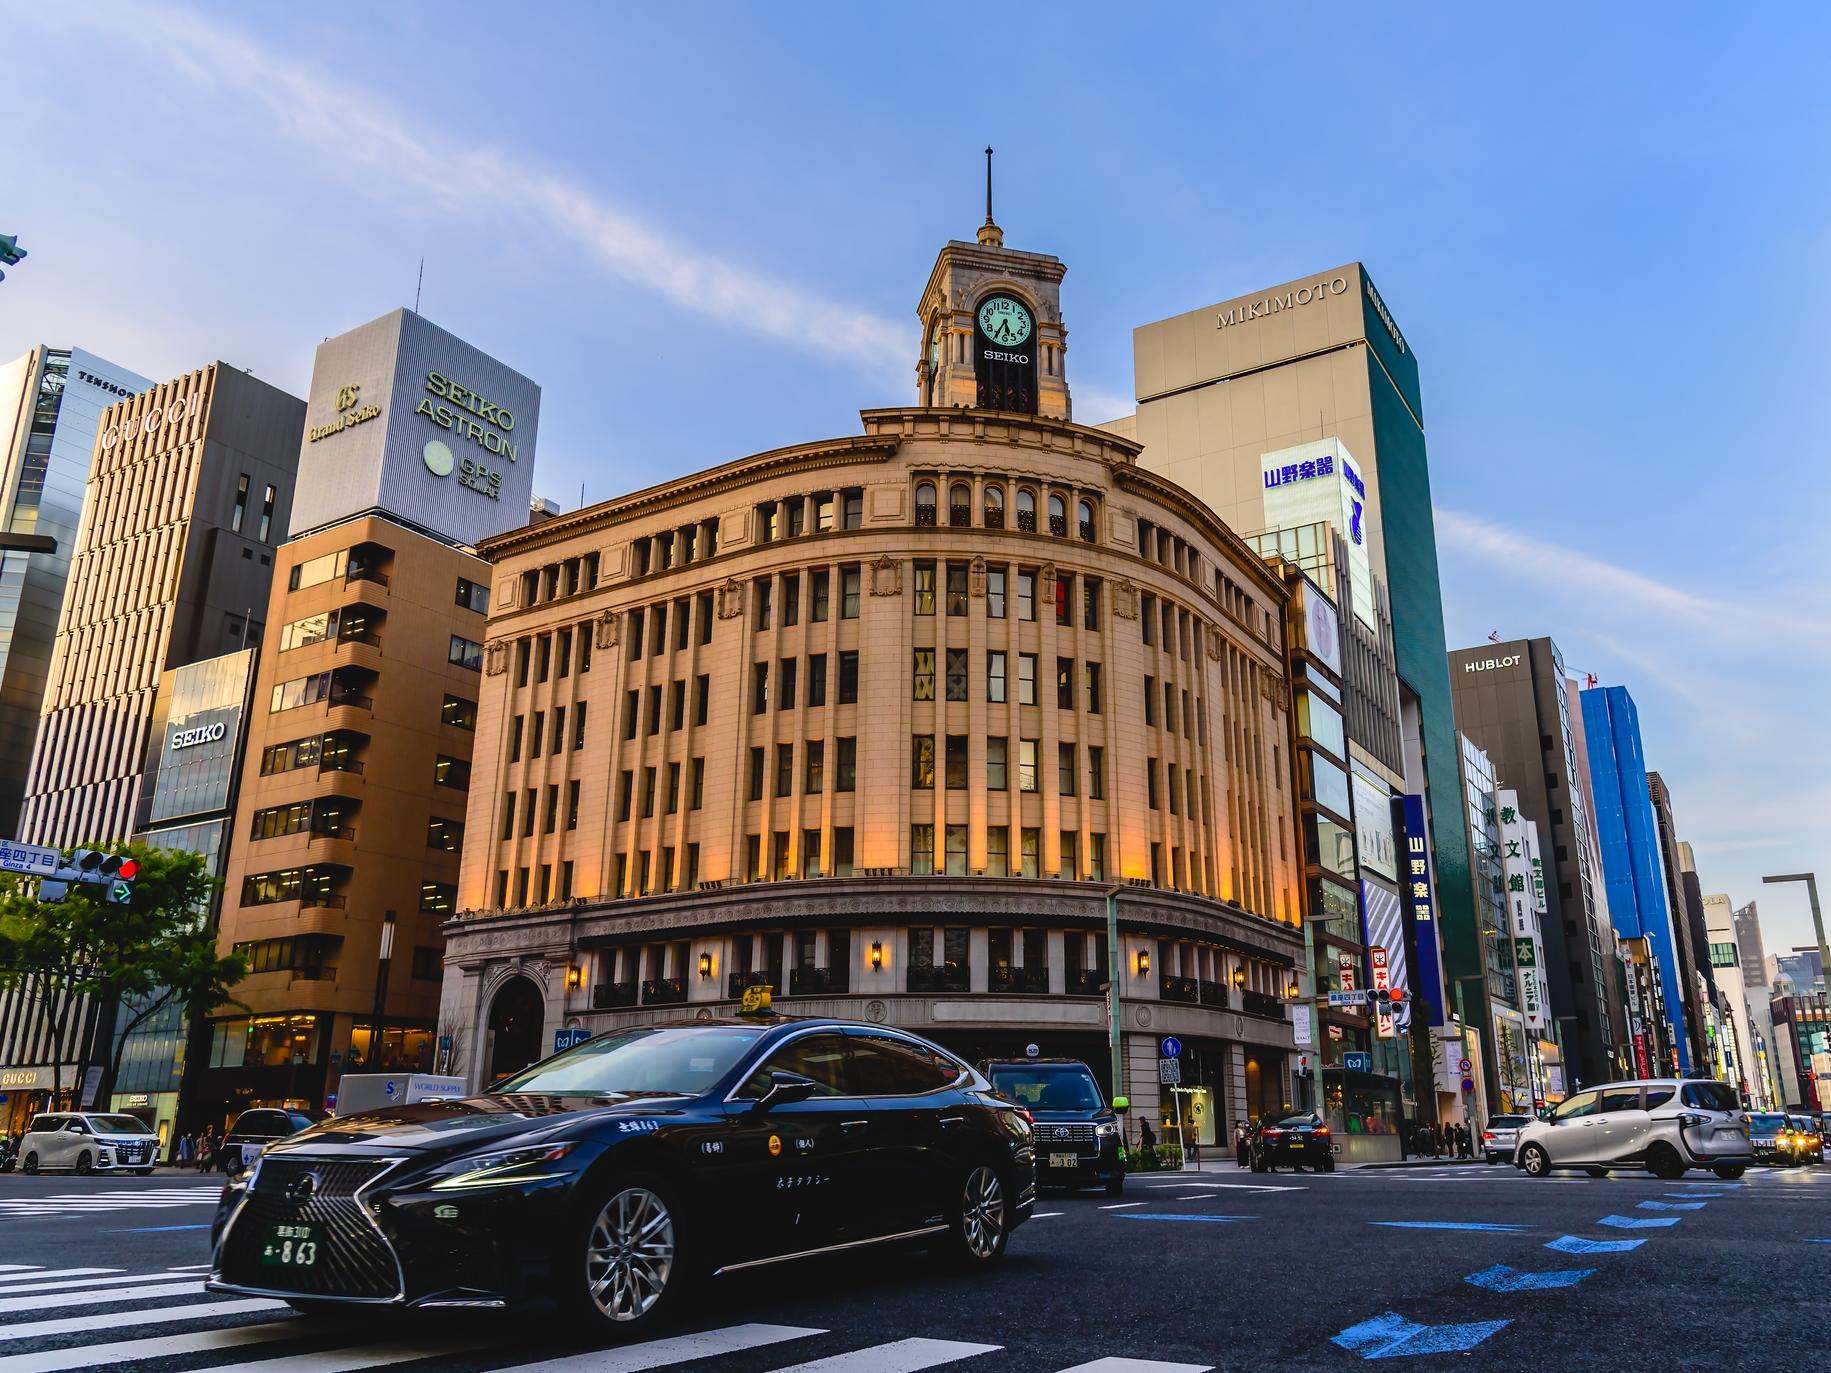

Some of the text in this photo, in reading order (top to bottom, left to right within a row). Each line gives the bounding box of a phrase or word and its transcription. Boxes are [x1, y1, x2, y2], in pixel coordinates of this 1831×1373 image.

[986, 307, 994, 315] 10
[993, 302, 1000, 310] 11
[1001, 302, 1010, 310] 12
[1012, 305, 1015, 313] 1
[1216, 277, 1347, 330] MIKIMOTO
[983, 315, 990, 323] 9
[1017, 312, 1023, 320] 2
[1020, 320, 1026, 329] 3
[986, 324, 993, 332] 8
[1010, 333, 1017, 341] 5
[1001, 334, 1009, 342] 6
[984, 350, 1029, 364] SEIKO
[427, 370, 515, 432] SEIKO
[102, 392, 198, 450] GUCCI
[346, 404, 380, 427] Seiko
[414, 398, 518, 463] ASTRON
[460, 456, 503, 489] GPS
[1264, 456, 1333, 488] 山野楽器
[457, 473, 501, 501] SOLAR
[1465, 655, 1521, 673] HUBLOT
[171, 722, 225, 750] SEIKO
[0, 848, 54, 866] 座四丁目
[1500, 806, 1525, 893] 教文館
[3, 860, 23, 869] Ginza
[1409, 837, 1430, 920] 山野楽器
[1517, 942, 1532, 962] 本
[3, 1072, 37, 1085] GUCCI
